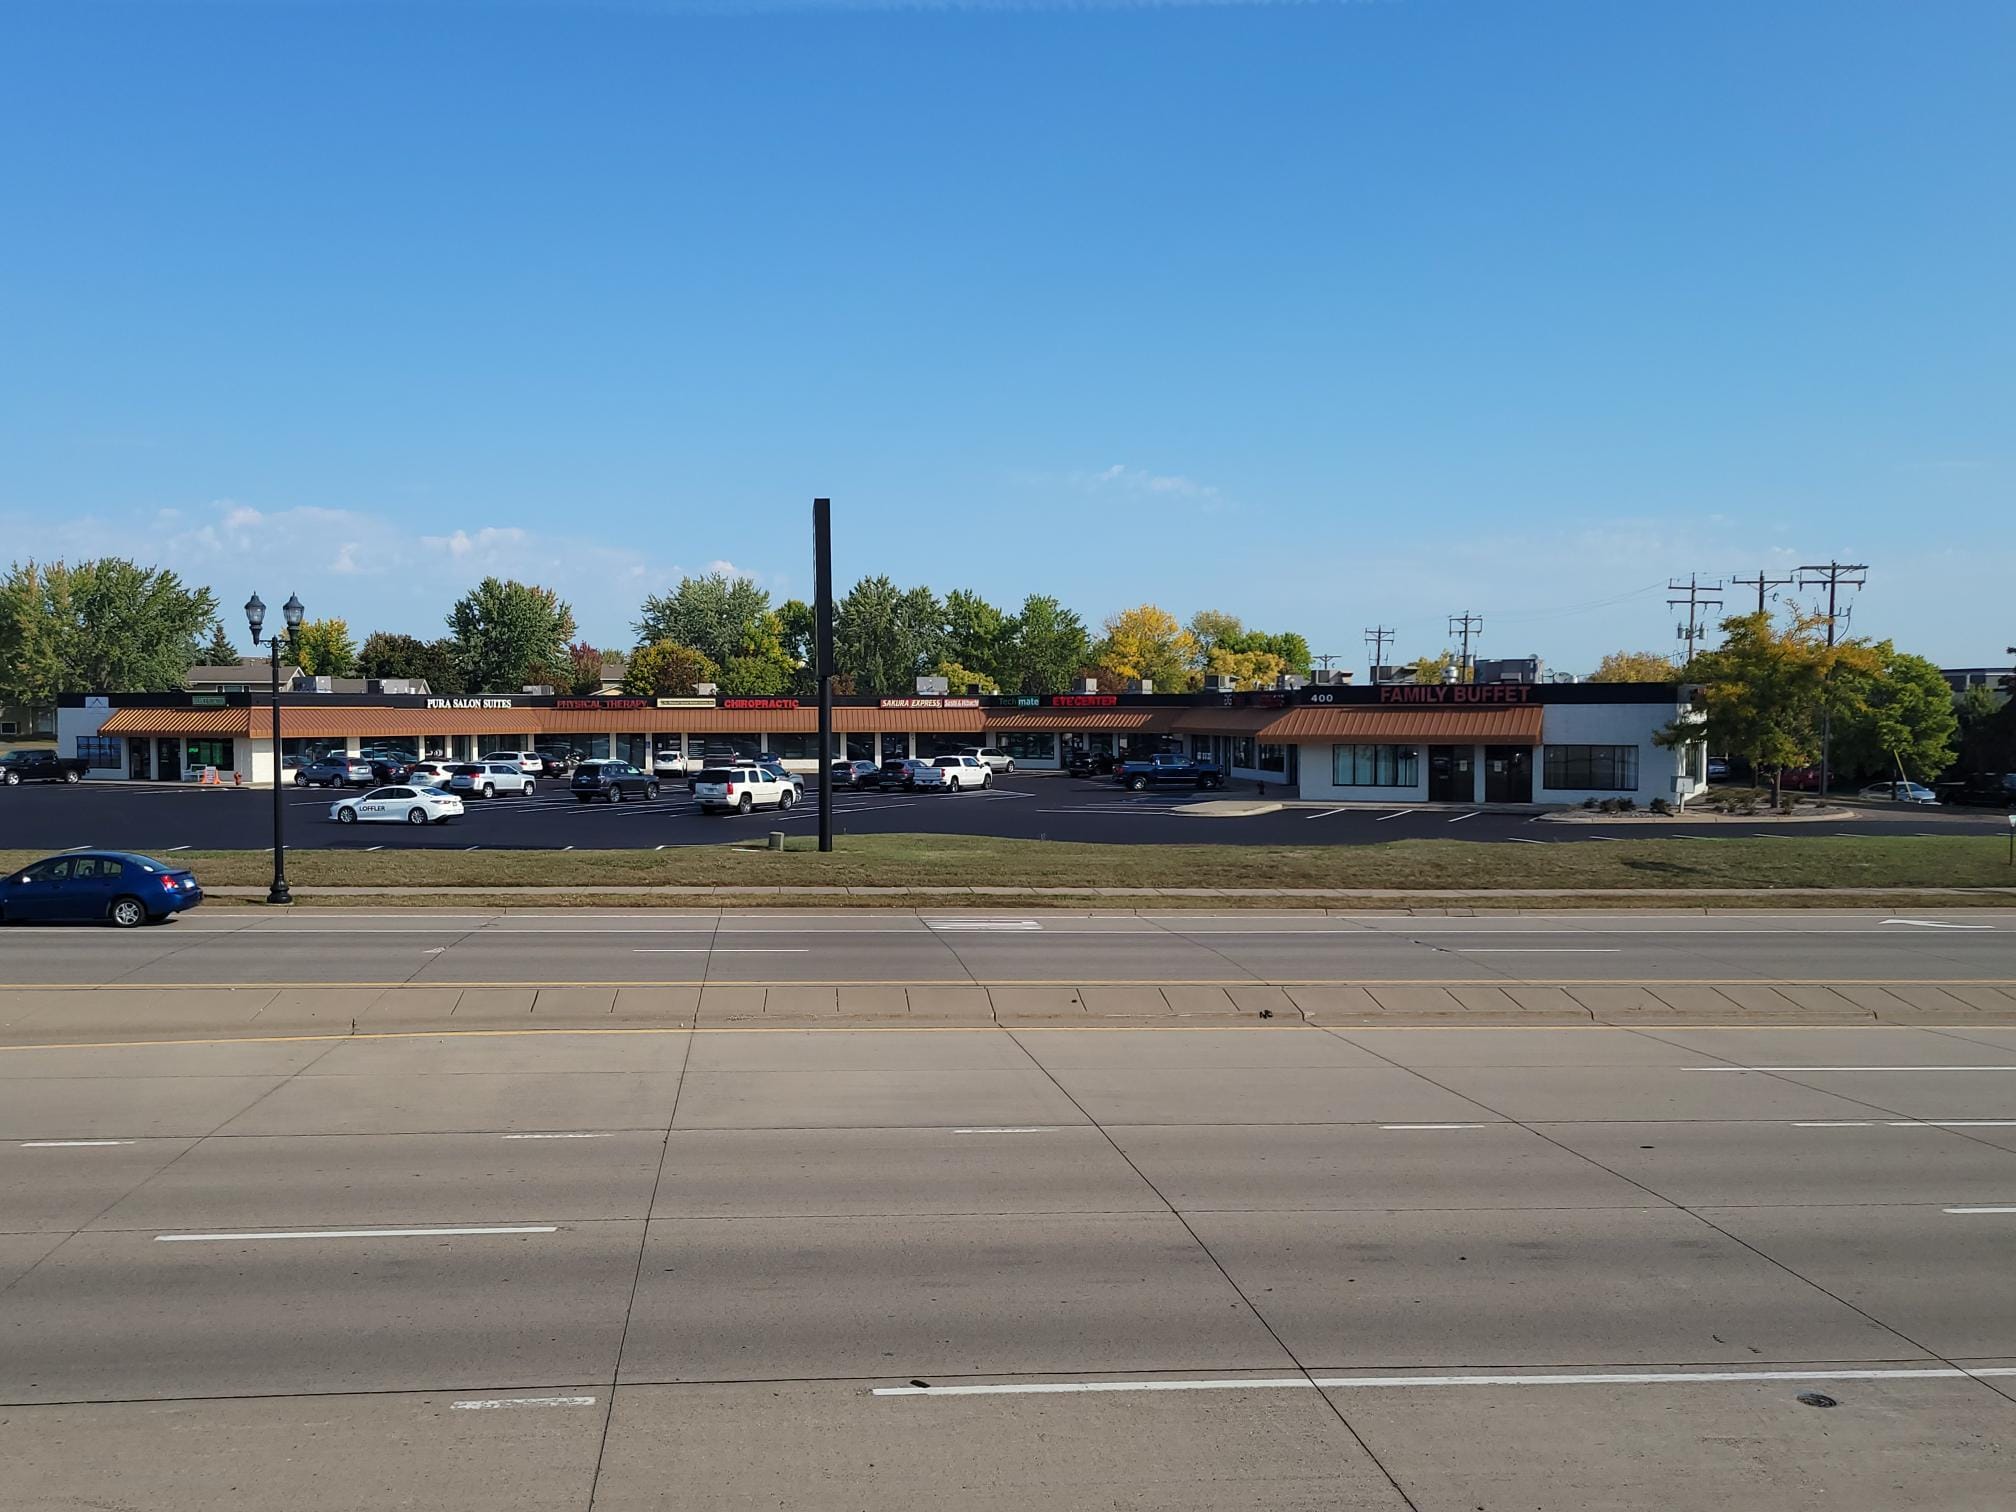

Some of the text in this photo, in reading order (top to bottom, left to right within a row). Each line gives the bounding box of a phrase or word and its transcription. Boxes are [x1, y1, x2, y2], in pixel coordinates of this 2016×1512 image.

[1311, 694, 1333, 703] 400
[1380, 686, 1532, 702] FAMILY BUFFET
[427, 699, 512, 709] PURA SALON SUITES
[556, 699, 648, 709] PHYSICAL THERAPY
[724, 700, 800, 709] CHIROPRACTIC
[882, 699, 909, 707] SAKURA
[1018, 697, 1040, 706] mate
[1052, 696, 1117, 706] EYE CENTER
